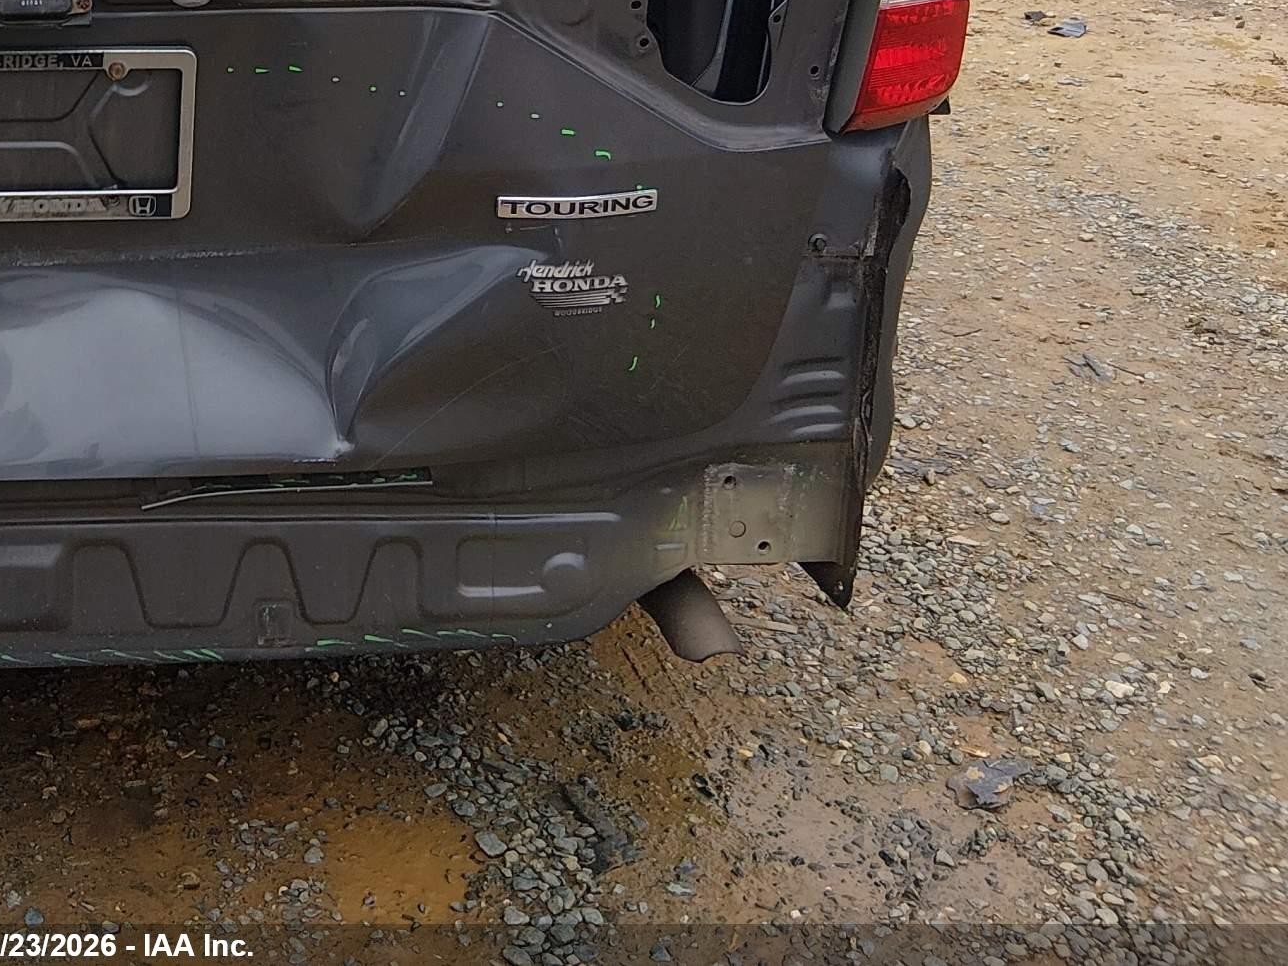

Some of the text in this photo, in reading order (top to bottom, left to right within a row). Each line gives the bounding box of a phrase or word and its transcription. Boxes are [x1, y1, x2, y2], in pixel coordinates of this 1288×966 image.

[71, 54, 93, 67] VA
[14, 197, 106, 215] HONDA
[503, 195, 654, 215] TOURING
[516, 259, 595, 283] Hendrick
[531, 274, 629, 293] HONDA
